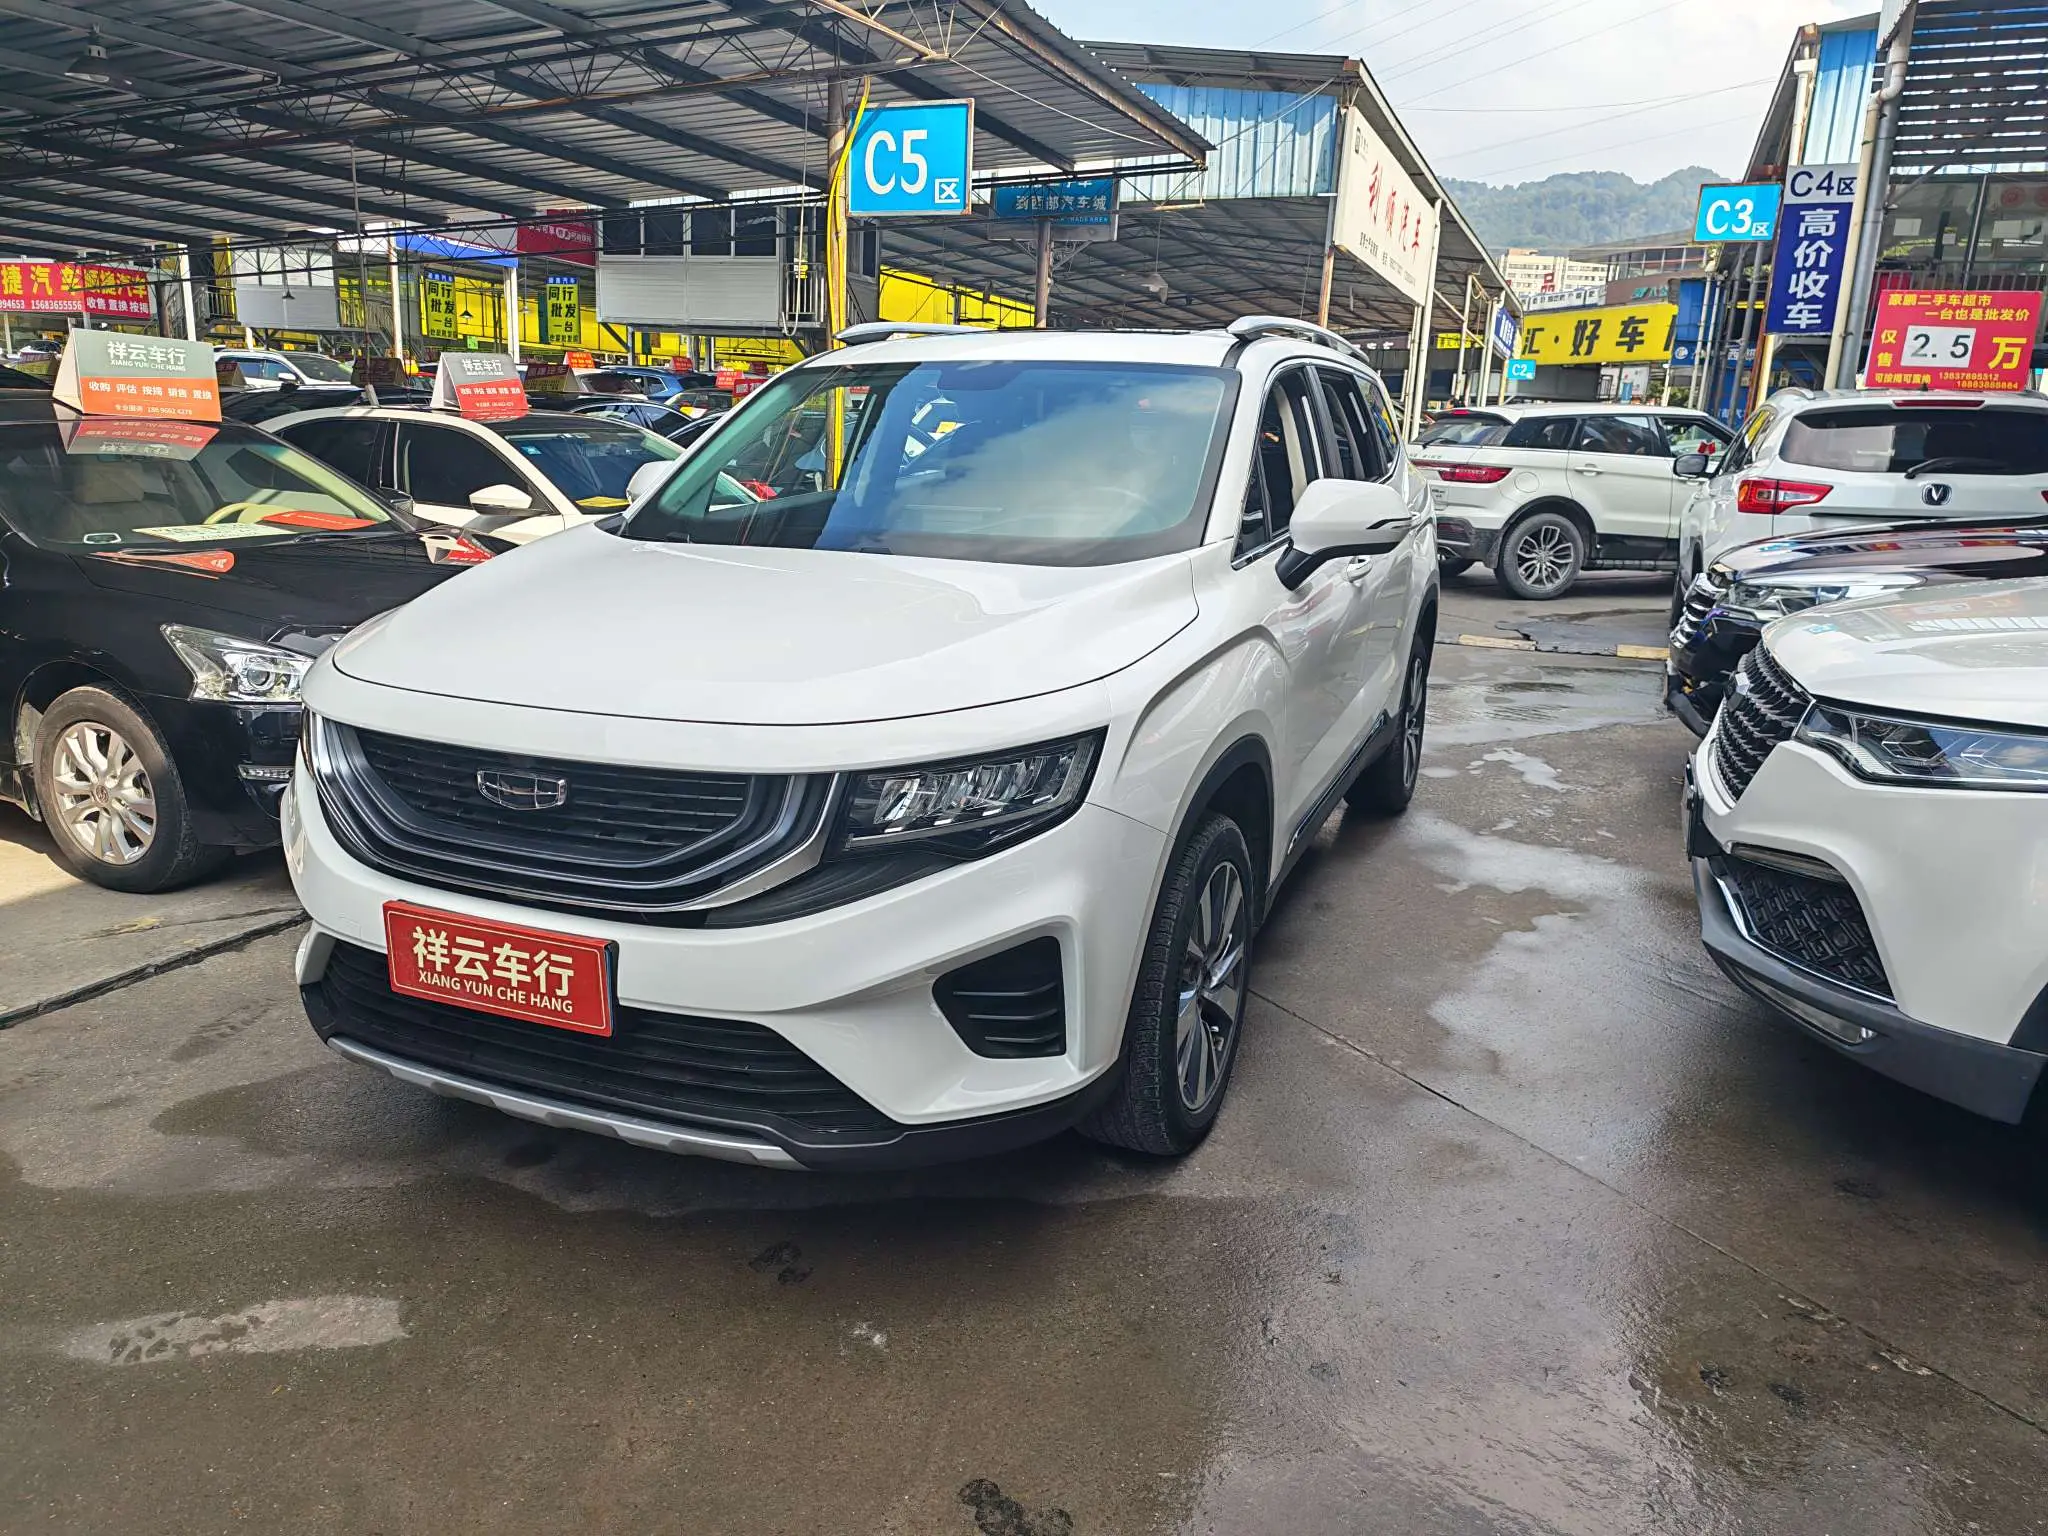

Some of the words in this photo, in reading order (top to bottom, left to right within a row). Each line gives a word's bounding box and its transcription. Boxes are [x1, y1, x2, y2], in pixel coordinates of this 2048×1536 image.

[865, 129, 961, 204] C5区
[1790, 170, 1857, 197] C4区
[1706, 199, 1770, 236] C3区
[1783, 208, 1839, 329] 高价收车
[549, 286, 574, 301] 同行
[551, 303, 576, 318] 批发
[1925, 308, 2030, 321] 一台也是批发价
[553, 321, 573, 333] 一台
[107, 341, 186, 365] 祥云车行
[1877, 329, 1898, 367] 仅售
[1910, 333, 1971, 359] 2.5
[1987, 336, 2027, 370] 万
[111, 359, 133, 367] XIANG
[462, 358, 502, 372] 祥云车行
[89, 381, 111, 393] 收购
[116, 383, 137, 395] 评估
[142, 386, 163, 397] 按揭
[168, 387, 188, 398] 销售
[192, 389, 212, 400] 置换
[412, 926, 574, 997] 祥云车行
[418, 969, 461, 991] XIANG
[464, 980, 493, 998] YUN
[497, 986, 526, 1004] CHE
[531, 993, 573, 1014] HANG
